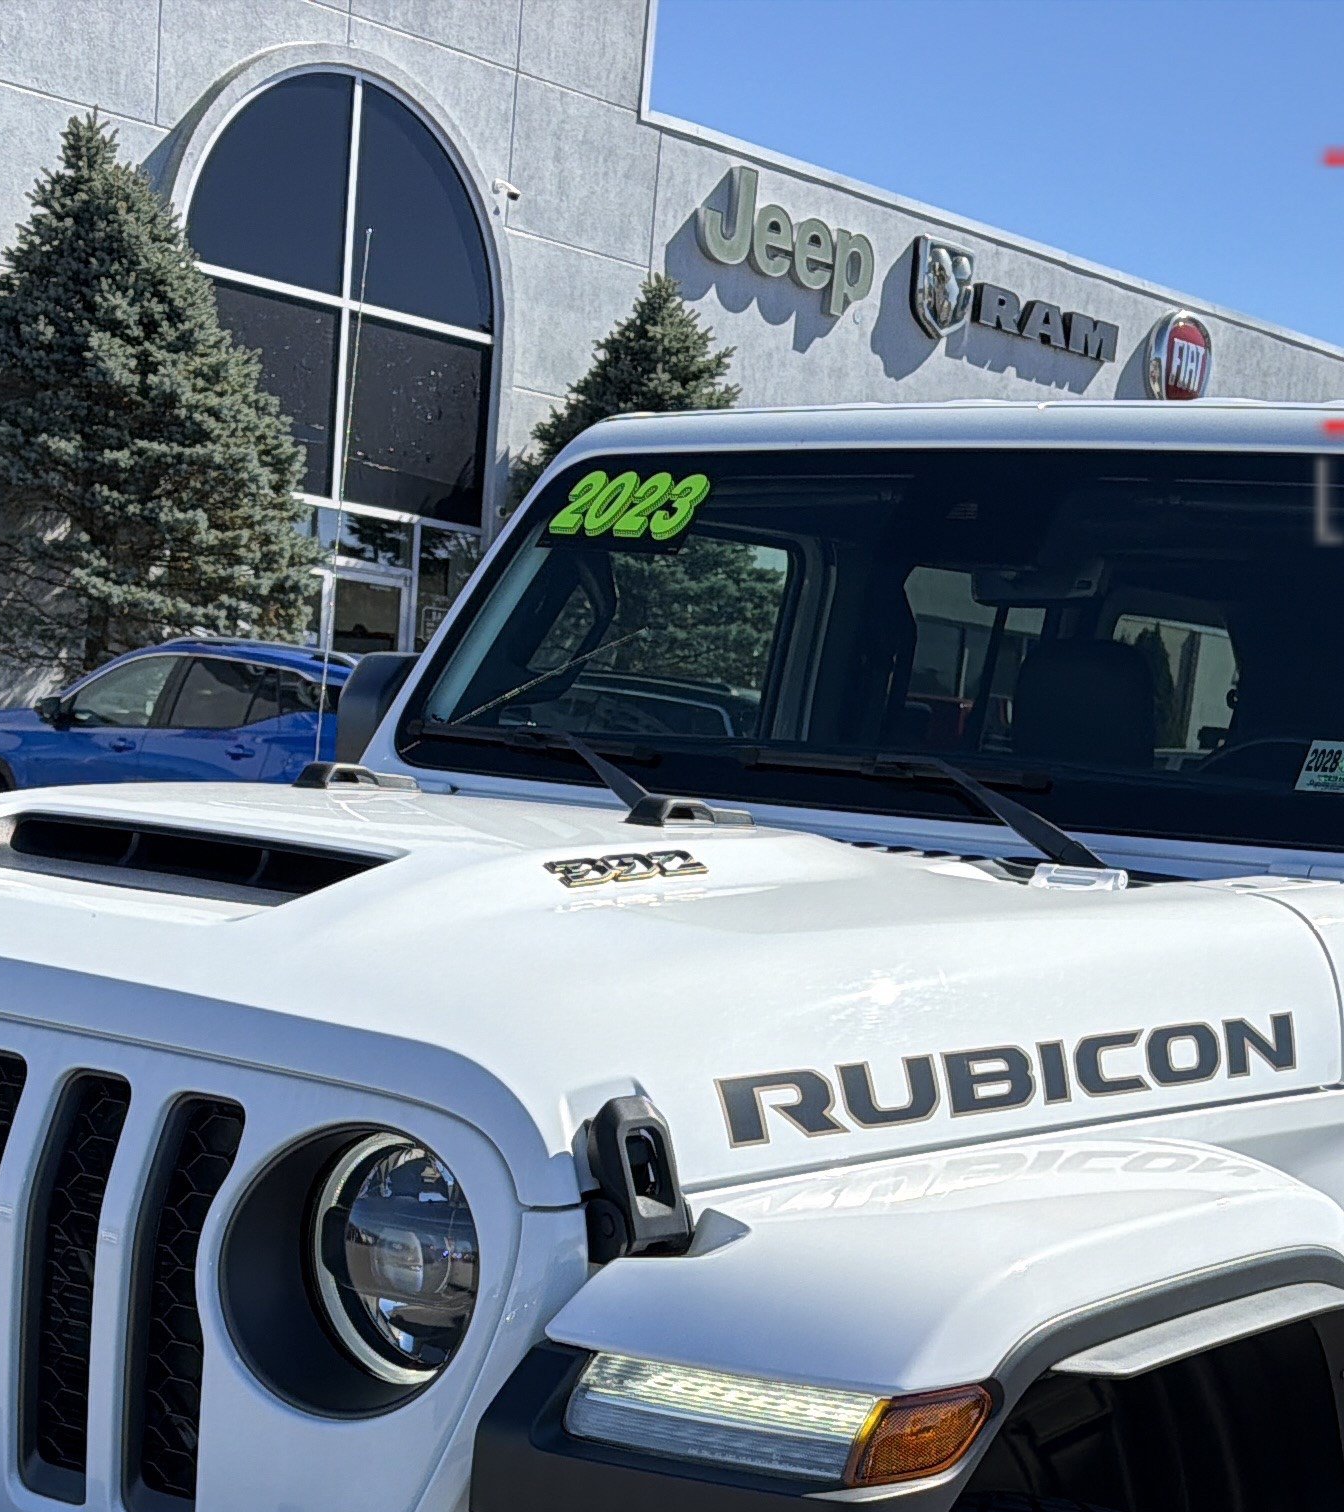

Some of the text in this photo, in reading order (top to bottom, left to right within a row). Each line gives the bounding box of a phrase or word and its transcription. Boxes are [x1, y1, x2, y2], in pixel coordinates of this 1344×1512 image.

[698, 165, 875, 317] Jeep
[972, 282, 1119, 363] RAM
[1168, 337, 1205, 393] FIAT
[549, 470, 710, 541] 2023
[1305, 748, 1342, 773] 2028
[714, 1011, 1297, 1148] RUBICON
